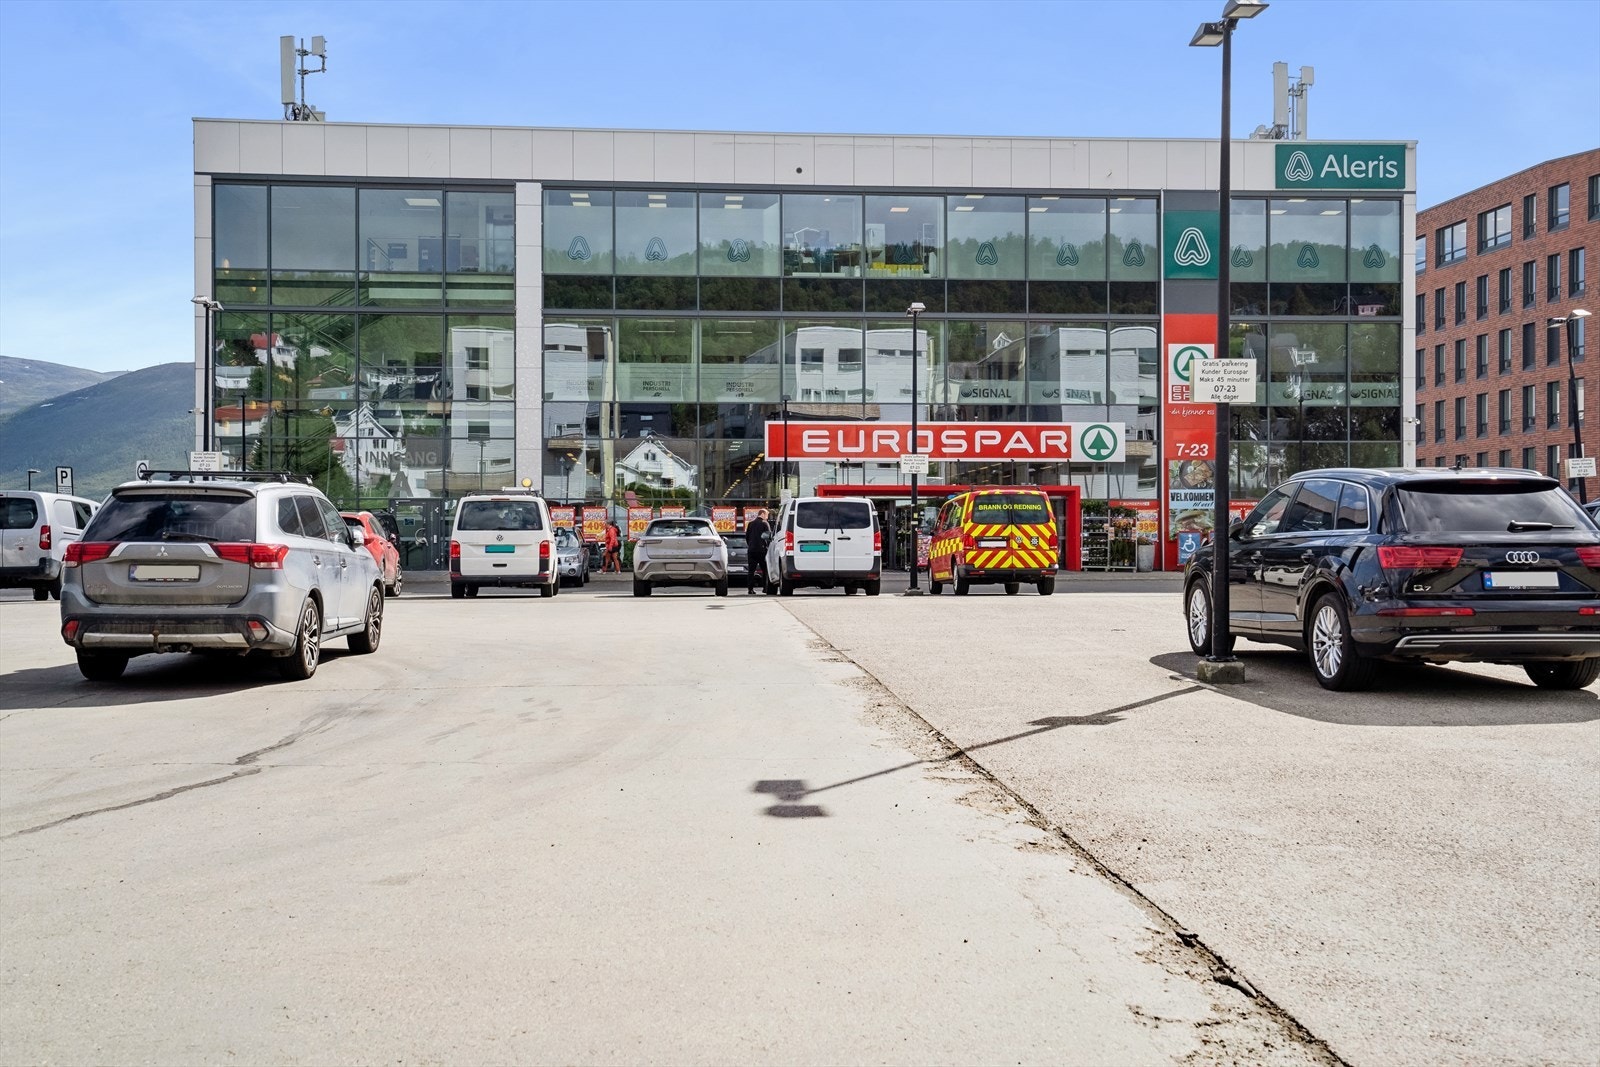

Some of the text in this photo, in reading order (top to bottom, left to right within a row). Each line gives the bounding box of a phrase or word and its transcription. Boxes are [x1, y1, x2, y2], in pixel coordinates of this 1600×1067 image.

[1320, 154, 1398, 178] Aleris
[1221, 360, 1249, 368] parkering
[971, 388, 1012, 398] SIGNAL
[1053, 388, 1092, 399] SGNAL
[1213, 385, 1237, 393] 07-23
[1223, 394, 1239, 402] dager
[802, 429, 1068, 454] EUROSPAR
[1175, 443, 1209, 456] 7-23
[365, 451, 437, 464] INNGANG
[60, 470, 68, 484] P
[1170, 492, 1214, 501] VELKOMMEN
[1413, 584, 1431, 592] Q7
